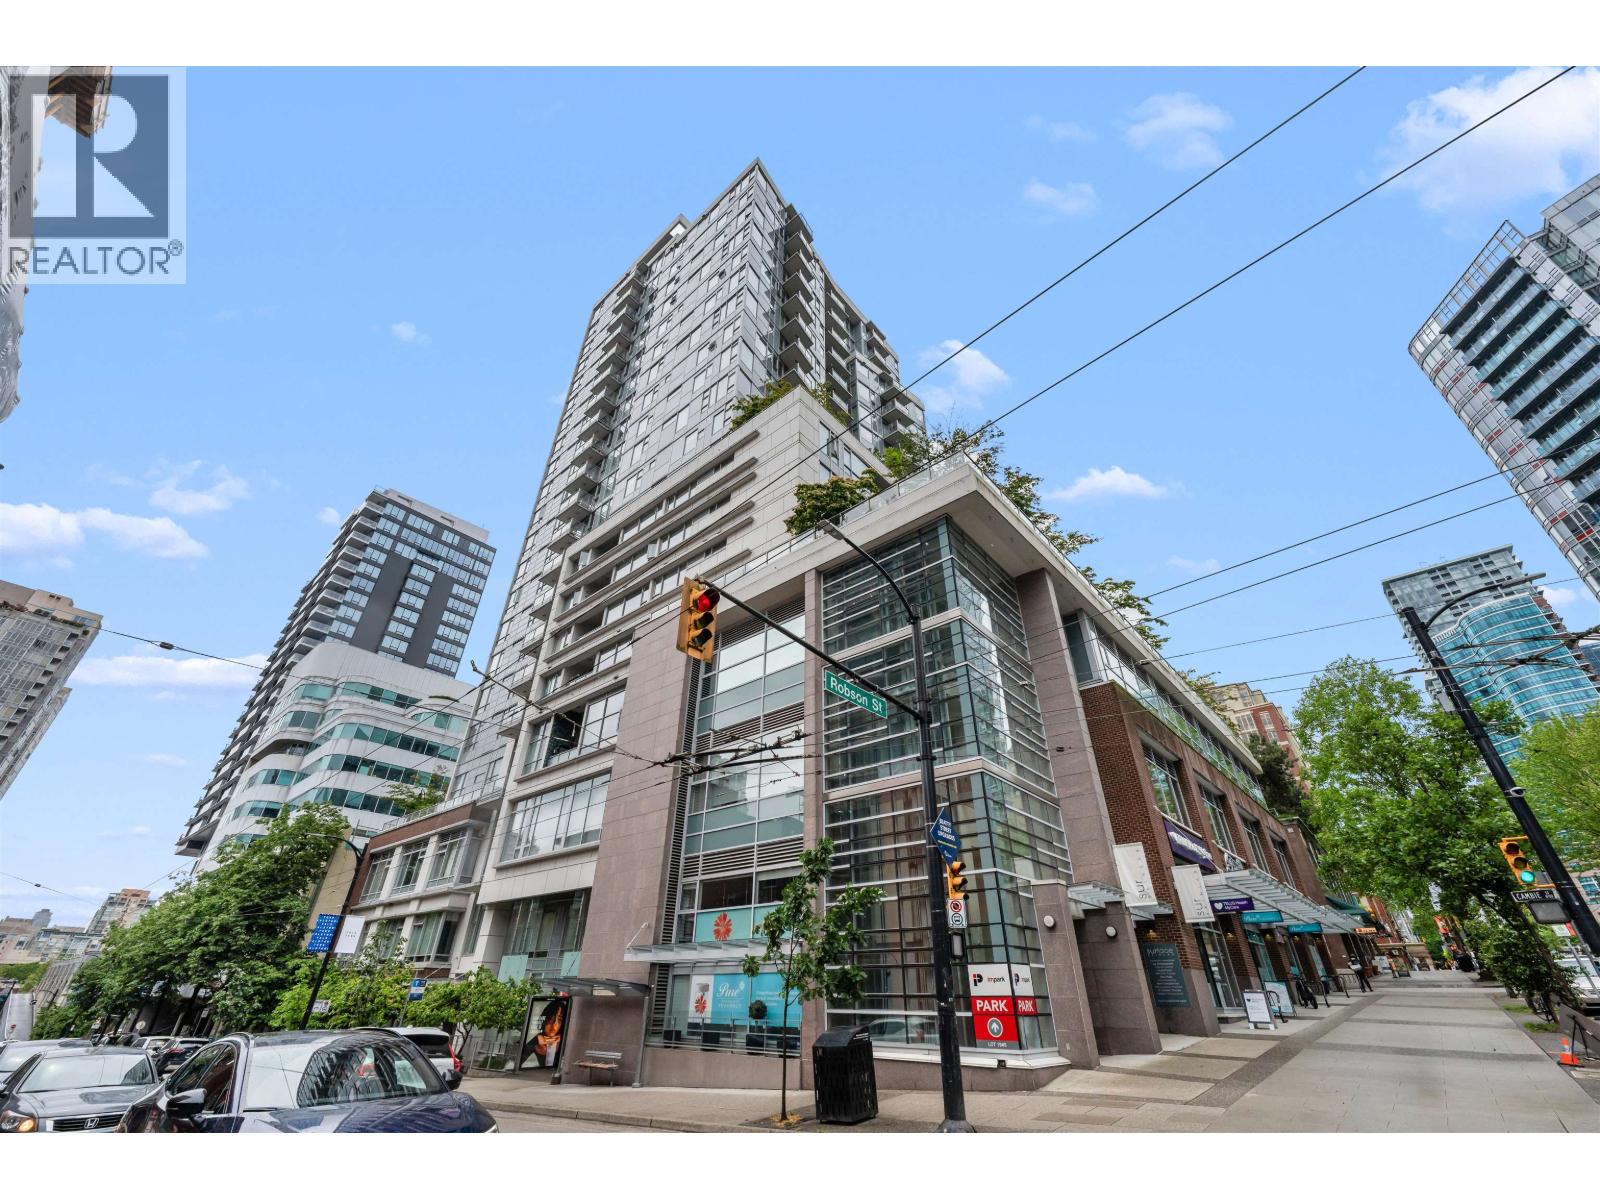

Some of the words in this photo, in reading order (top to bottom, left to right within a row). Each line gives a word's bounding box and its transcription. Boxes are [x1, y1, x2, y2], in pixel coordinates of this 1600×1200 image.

[830, 676, 868, 707] Robson
[872, 698, 883, 714] St
[1515, 892, 1542, 900] CAMBIE
[976, 999, 1009, 1012] PARK
[1018, 1000, 1035, 1012] PARK
